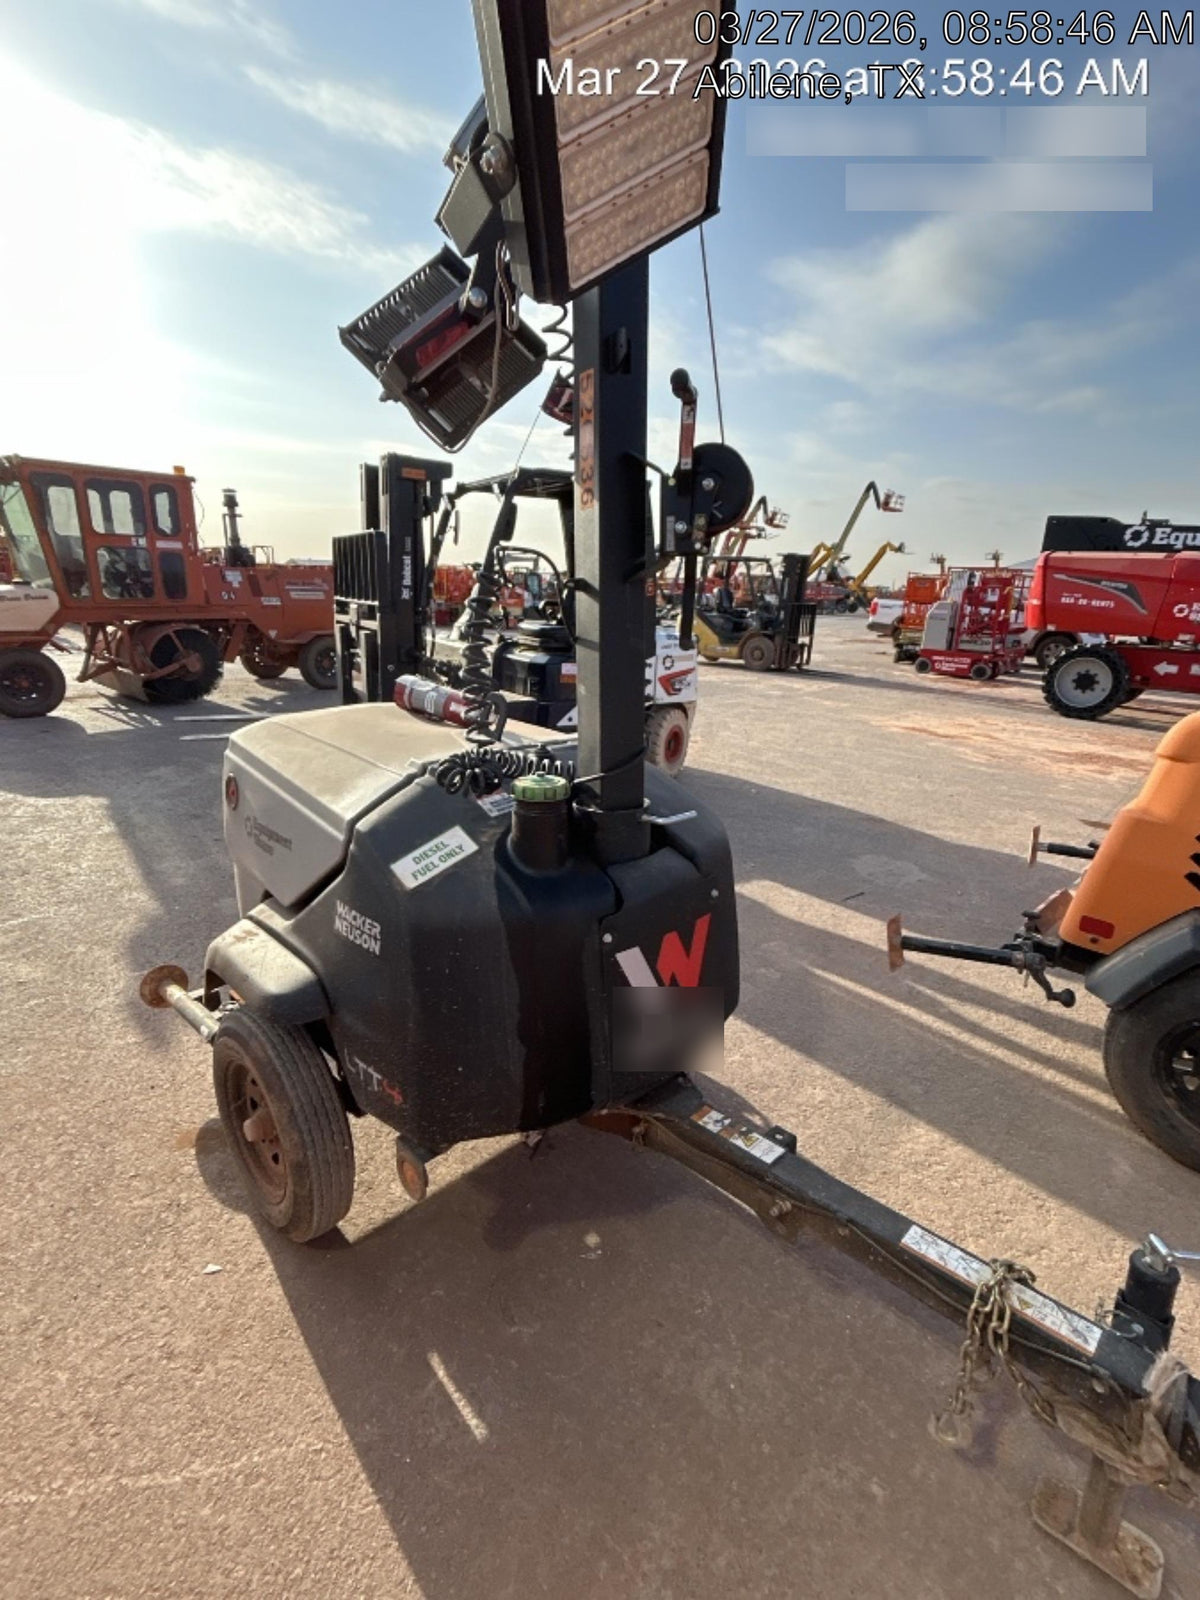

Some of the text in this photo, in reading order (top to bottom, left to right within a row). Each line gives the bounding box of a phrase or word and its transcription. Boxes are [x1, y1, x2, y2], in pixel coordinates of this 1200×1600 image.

[410, 843, 465, 881] FUEL ONLY
[412, 840, 450, 866] DIESEL
[334, 915, 381, 956] NEUSON
[336, 900, 381, 940] WACKER
